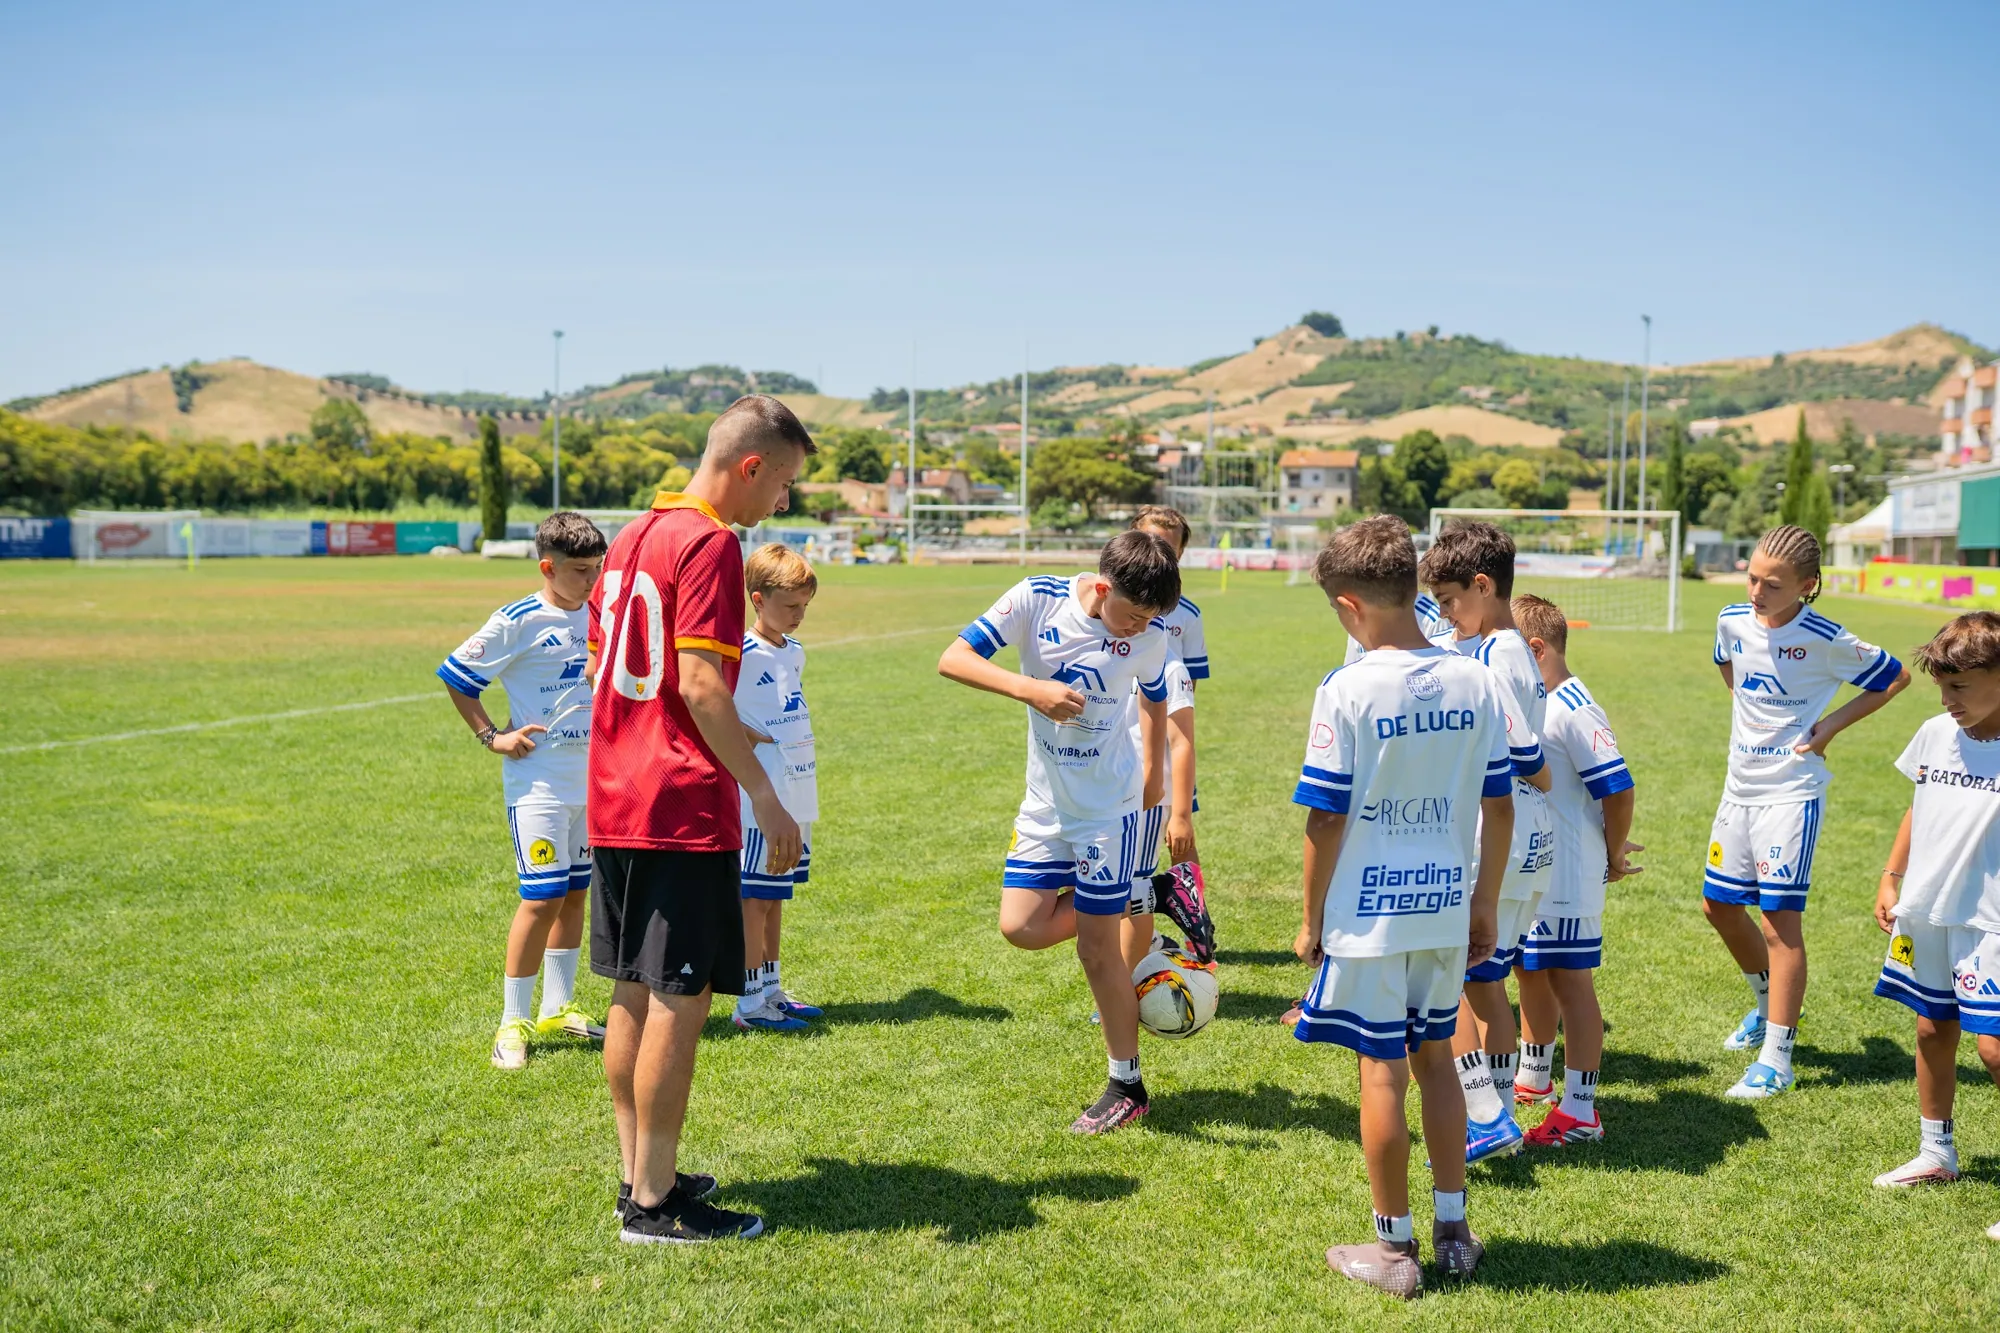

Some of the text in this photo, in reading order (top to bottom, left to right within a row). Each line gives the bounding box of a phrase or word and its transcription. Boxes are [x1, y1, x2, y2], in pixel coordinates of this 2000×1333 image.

[1405, 676, 1442, 686] REPLAY
[1408, 684, 1444, 694] WORLD
[1083, 694, 1119, 705] STRUZIONI
[1756, 696, 1808, 706] COSTRUZIONI
[1376, 709, 1474, 740] DE LUCA
[561, 729, 581, 739] VAL
[1057, 746, 1100, 758] VIBRATA
[795, 763, 807, 772] VAL
[1380, 797, 1454, 826] REGENY
[1087, 845, 1099, 860] 30
[1769, 846, 1782, 859] 57
[1362, 862, 1463, 887] Giardina
[1356, 885, 1463, 917] Energie
[745, 987, 762, 997] didas
[1520, 1060, 1550, 1072] adidas
[1464, 1074, 1493, 1091] adidas
